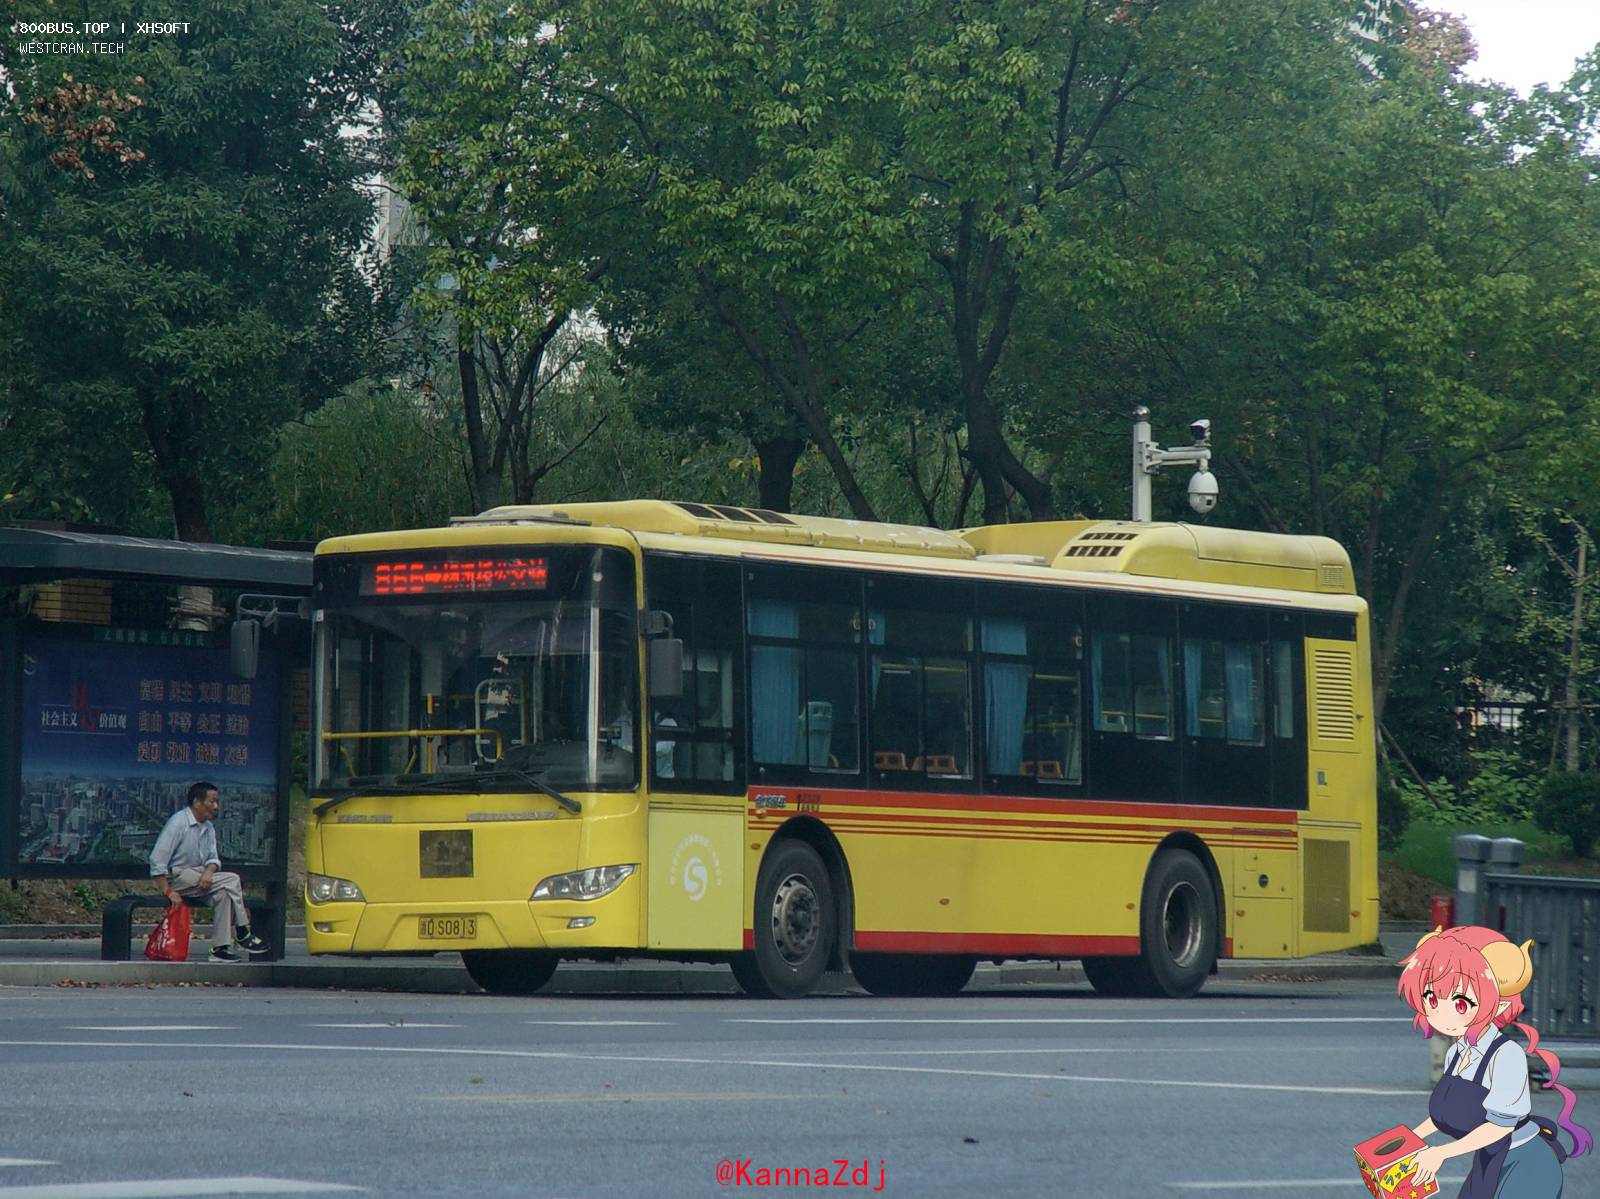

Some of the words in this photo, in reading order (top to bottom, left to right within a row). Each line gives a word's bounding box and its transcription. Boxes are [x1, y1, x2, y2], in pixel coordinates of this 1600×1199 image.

[41, 710, 78, 727] 社会主义
[99, 712, 127, 729] 价值观
